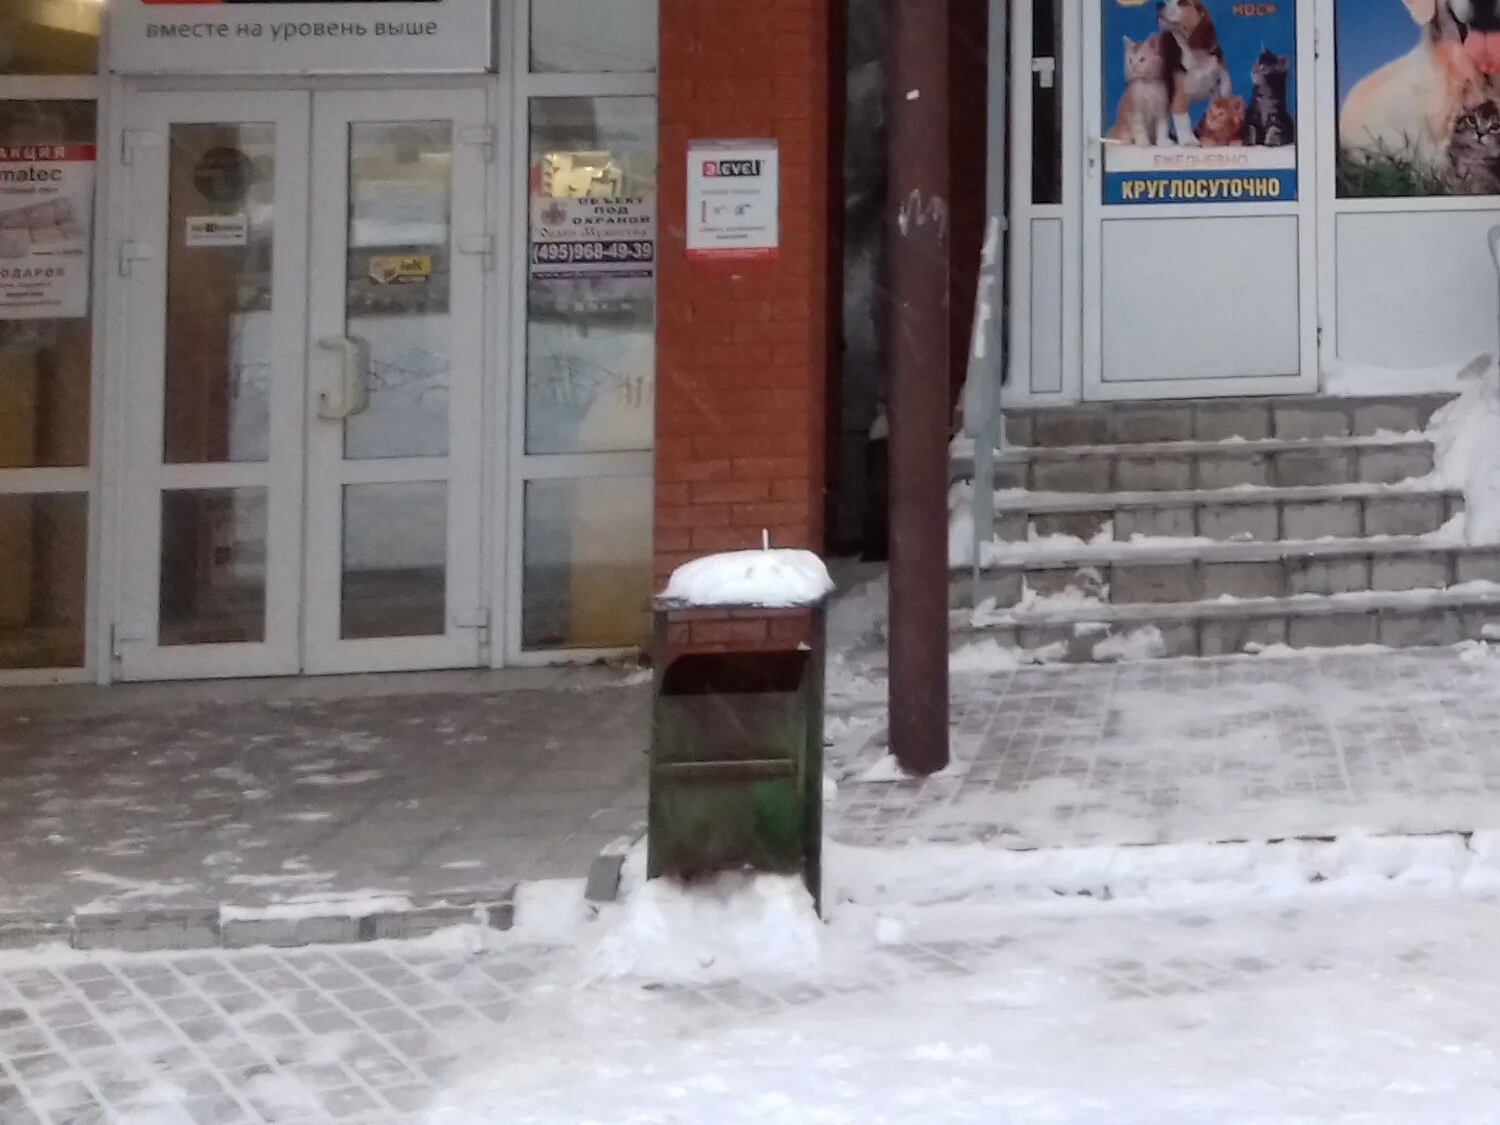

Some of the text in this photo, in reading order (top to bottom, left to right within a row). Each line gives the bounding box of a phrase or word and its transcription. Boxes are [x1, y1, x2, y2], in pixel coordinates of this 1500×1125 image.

[146, 20, 438, 42] вместе на уровень выше
[1122, 177, 1281, 199] КРУГЛОСУТОЧНО
